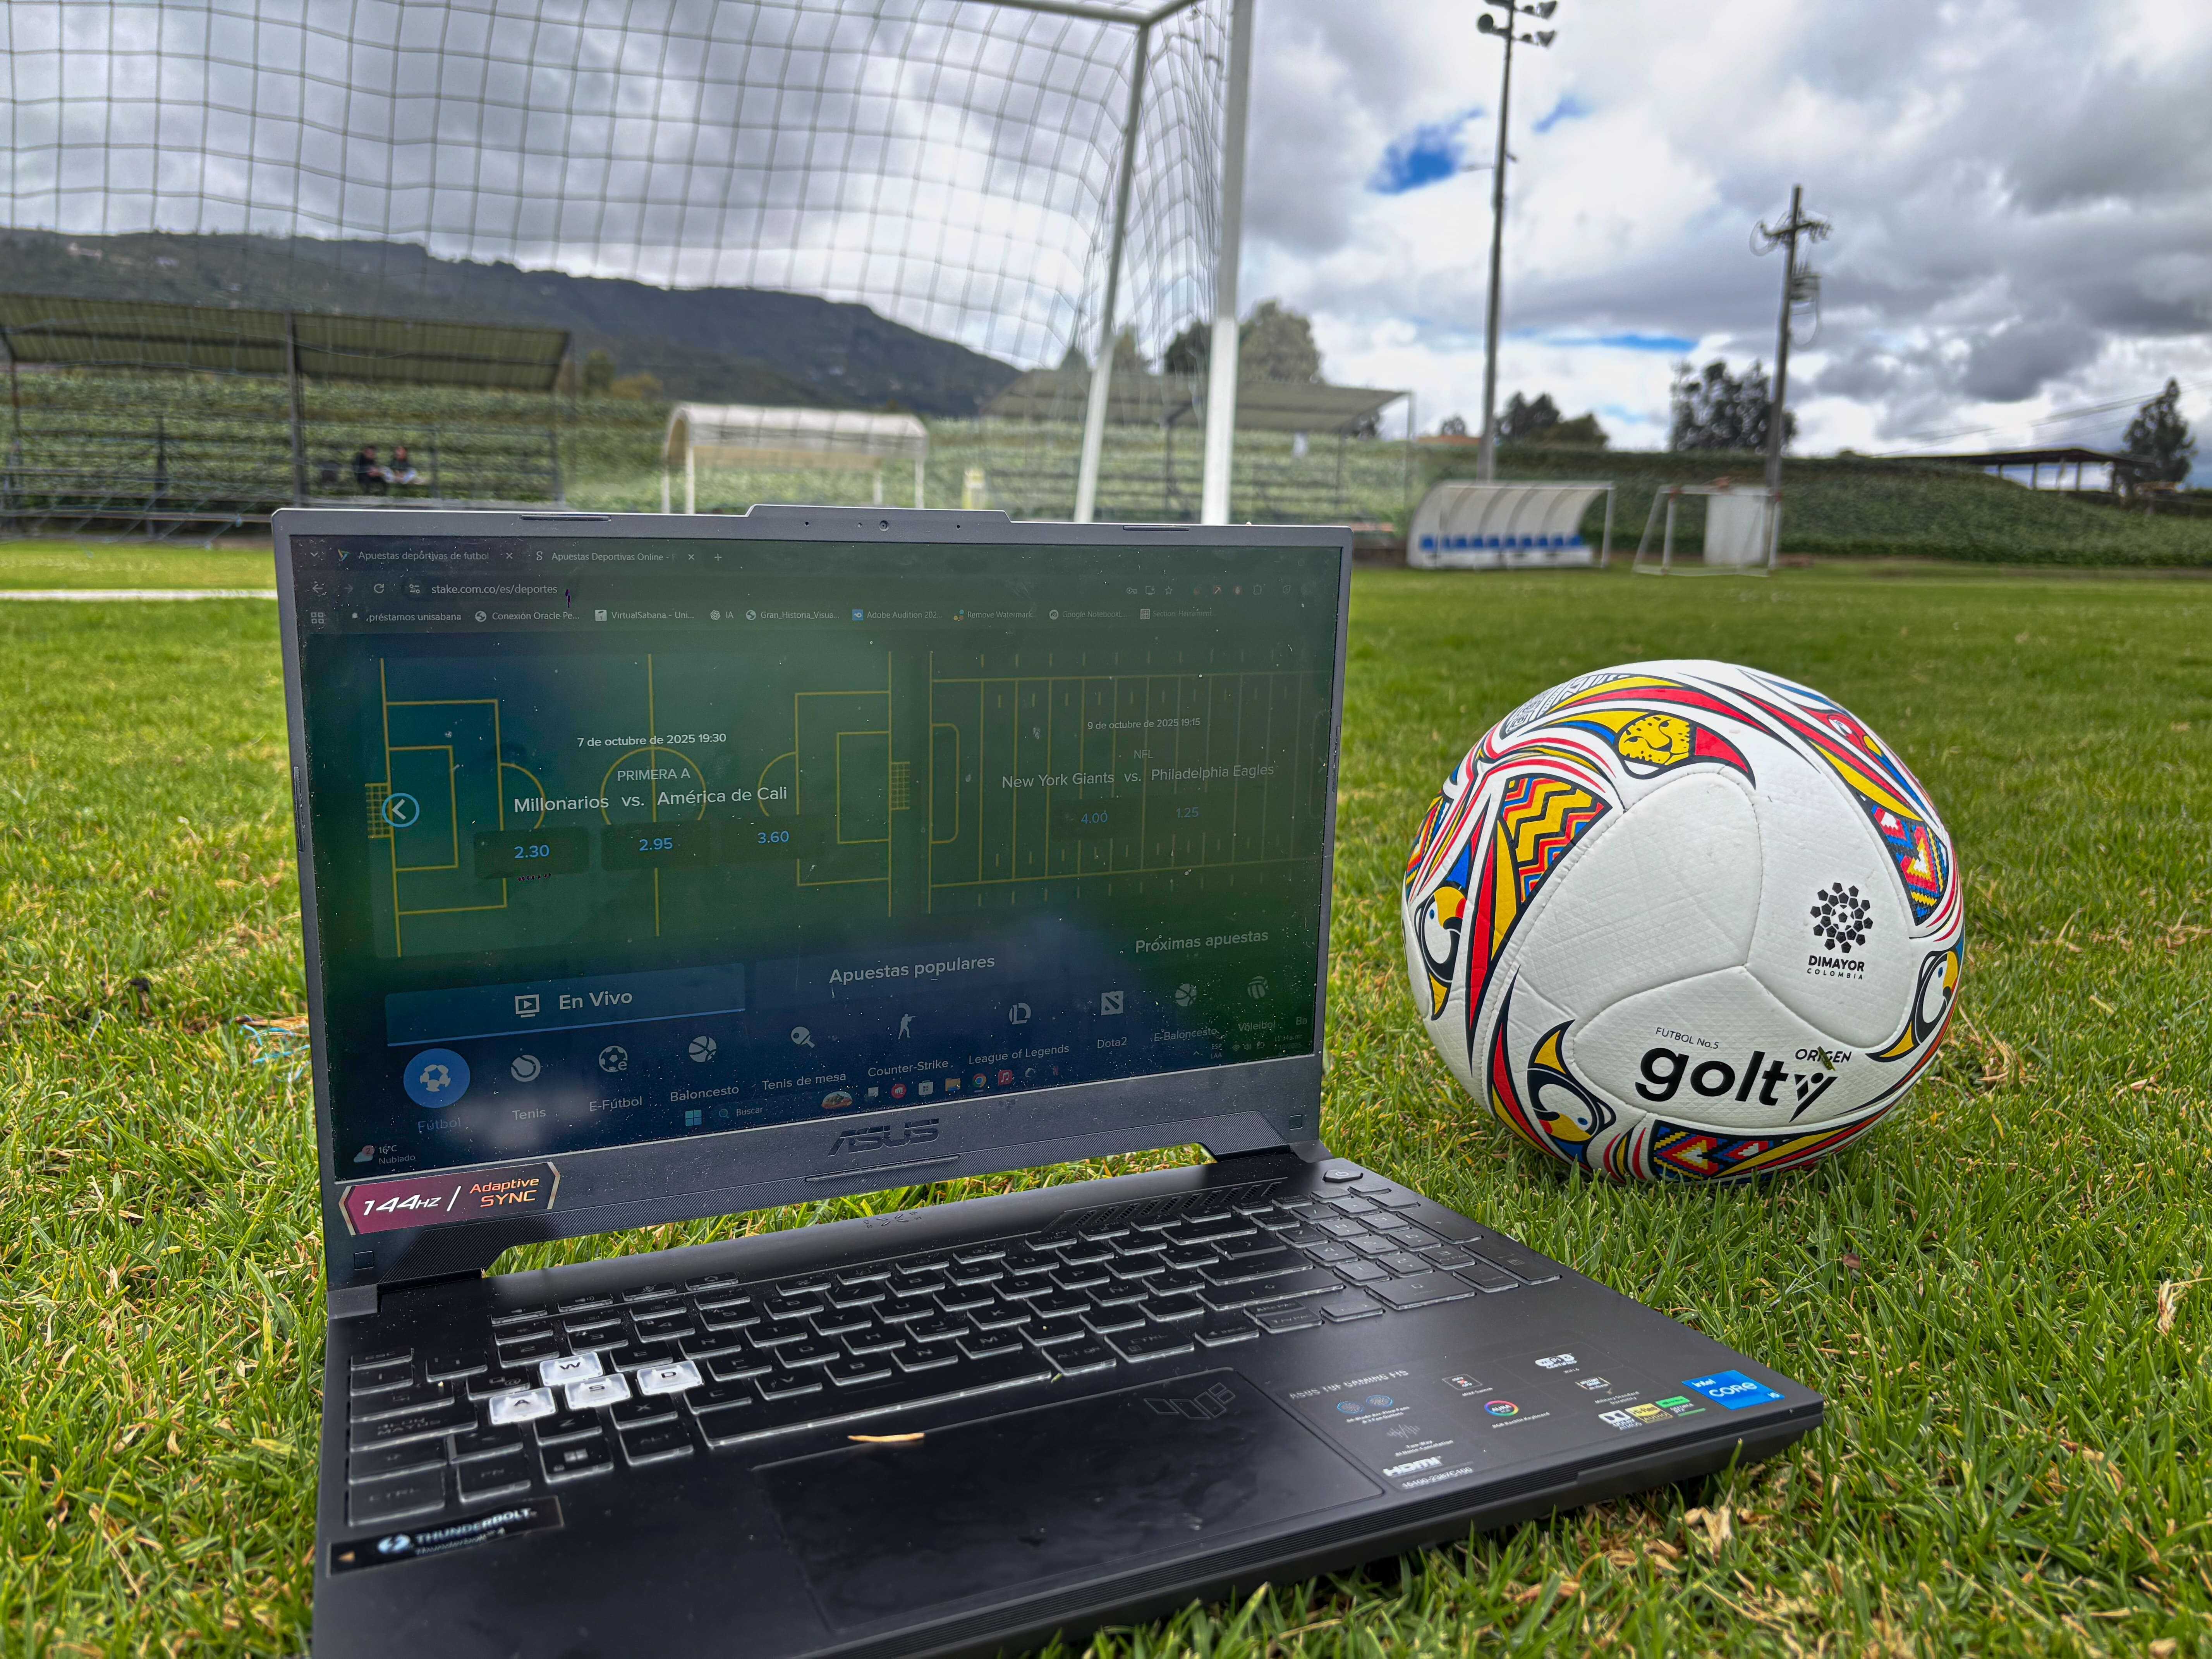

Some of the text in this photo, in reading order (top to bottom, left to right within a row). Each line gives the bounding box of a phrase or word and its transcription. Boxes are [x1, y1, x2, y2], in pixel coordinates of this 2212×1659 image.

[359, 551, 489, 561] Apuestas deportivas de futbol
[552, 552, 663, 561] Apuestas Deportivas Online
[431, 585, 558, 595] stake.com.co/es/deportes
[418, 612, 461, 621] unisabana
[492, 612, 531, 620] Conexión
[611, 611, 666, 619] VirtualSabana
[1062, 611, 1084, 619] Google
[1087, 718, 1201, 730] 9 de octubre de 2025 19:15
[577, 733, 726, 747] 7 de octubre de 2025 19:30
[1133, 750, 1154, 760] NFL
[617, 768, 690, 781] PRIMERA A
[1001, 764, 1274, 788] New York Giants vs. Philadelphia Eagles
[514, 787, 787, 812] Millonarios vs. América de Cali
[1081, 807, 1199, 824] 4.00 1.25
[514, 831, 790, 859] 2.30 2.95 3.60
[1135, 931, 1269, 954] Próximas apuestas
[1808, 955, 1865, 972] DIMAYOR
[828, 957, 996, 986] Apuestas populares
[1807, 968, 1863, 980] COLOMBIA
[560, 990, 633, 1010] En Vivo
[1656, 1027, 1694, 1044] FUTBOL
[1097, 1037, 1127, 1050] Dota2
[969, 1044, 1070, 1066] League of Legends
[1795, 1048, 1852, 1063] ORIGEN
[867, 1059, 949, 1077] Counter-Strike
[762, 1073, 847, 1091] Tenis de mesa
[1635, 1048, 1838, 1123] golty
[670, 1085, 739, 1103] Baloncesto
[589, 1096, 643, 1112] E-Fútbol
[736, 1105, 763, 1116] Buscar
[512, 1108, 546, 1120] Tenis
[417, 1118, 461, 1132] Fútbol
[827, 1118, 940, 1157] ASUS
[379, 1154, 416, 1164] Nublado
[470, 1178, 539, 1194] Adaptive
[481, 1190, 536, 1207] SYNC
[560, 1361, 581, 1370] W
[1691, 1378, 1717, 1388] intel
